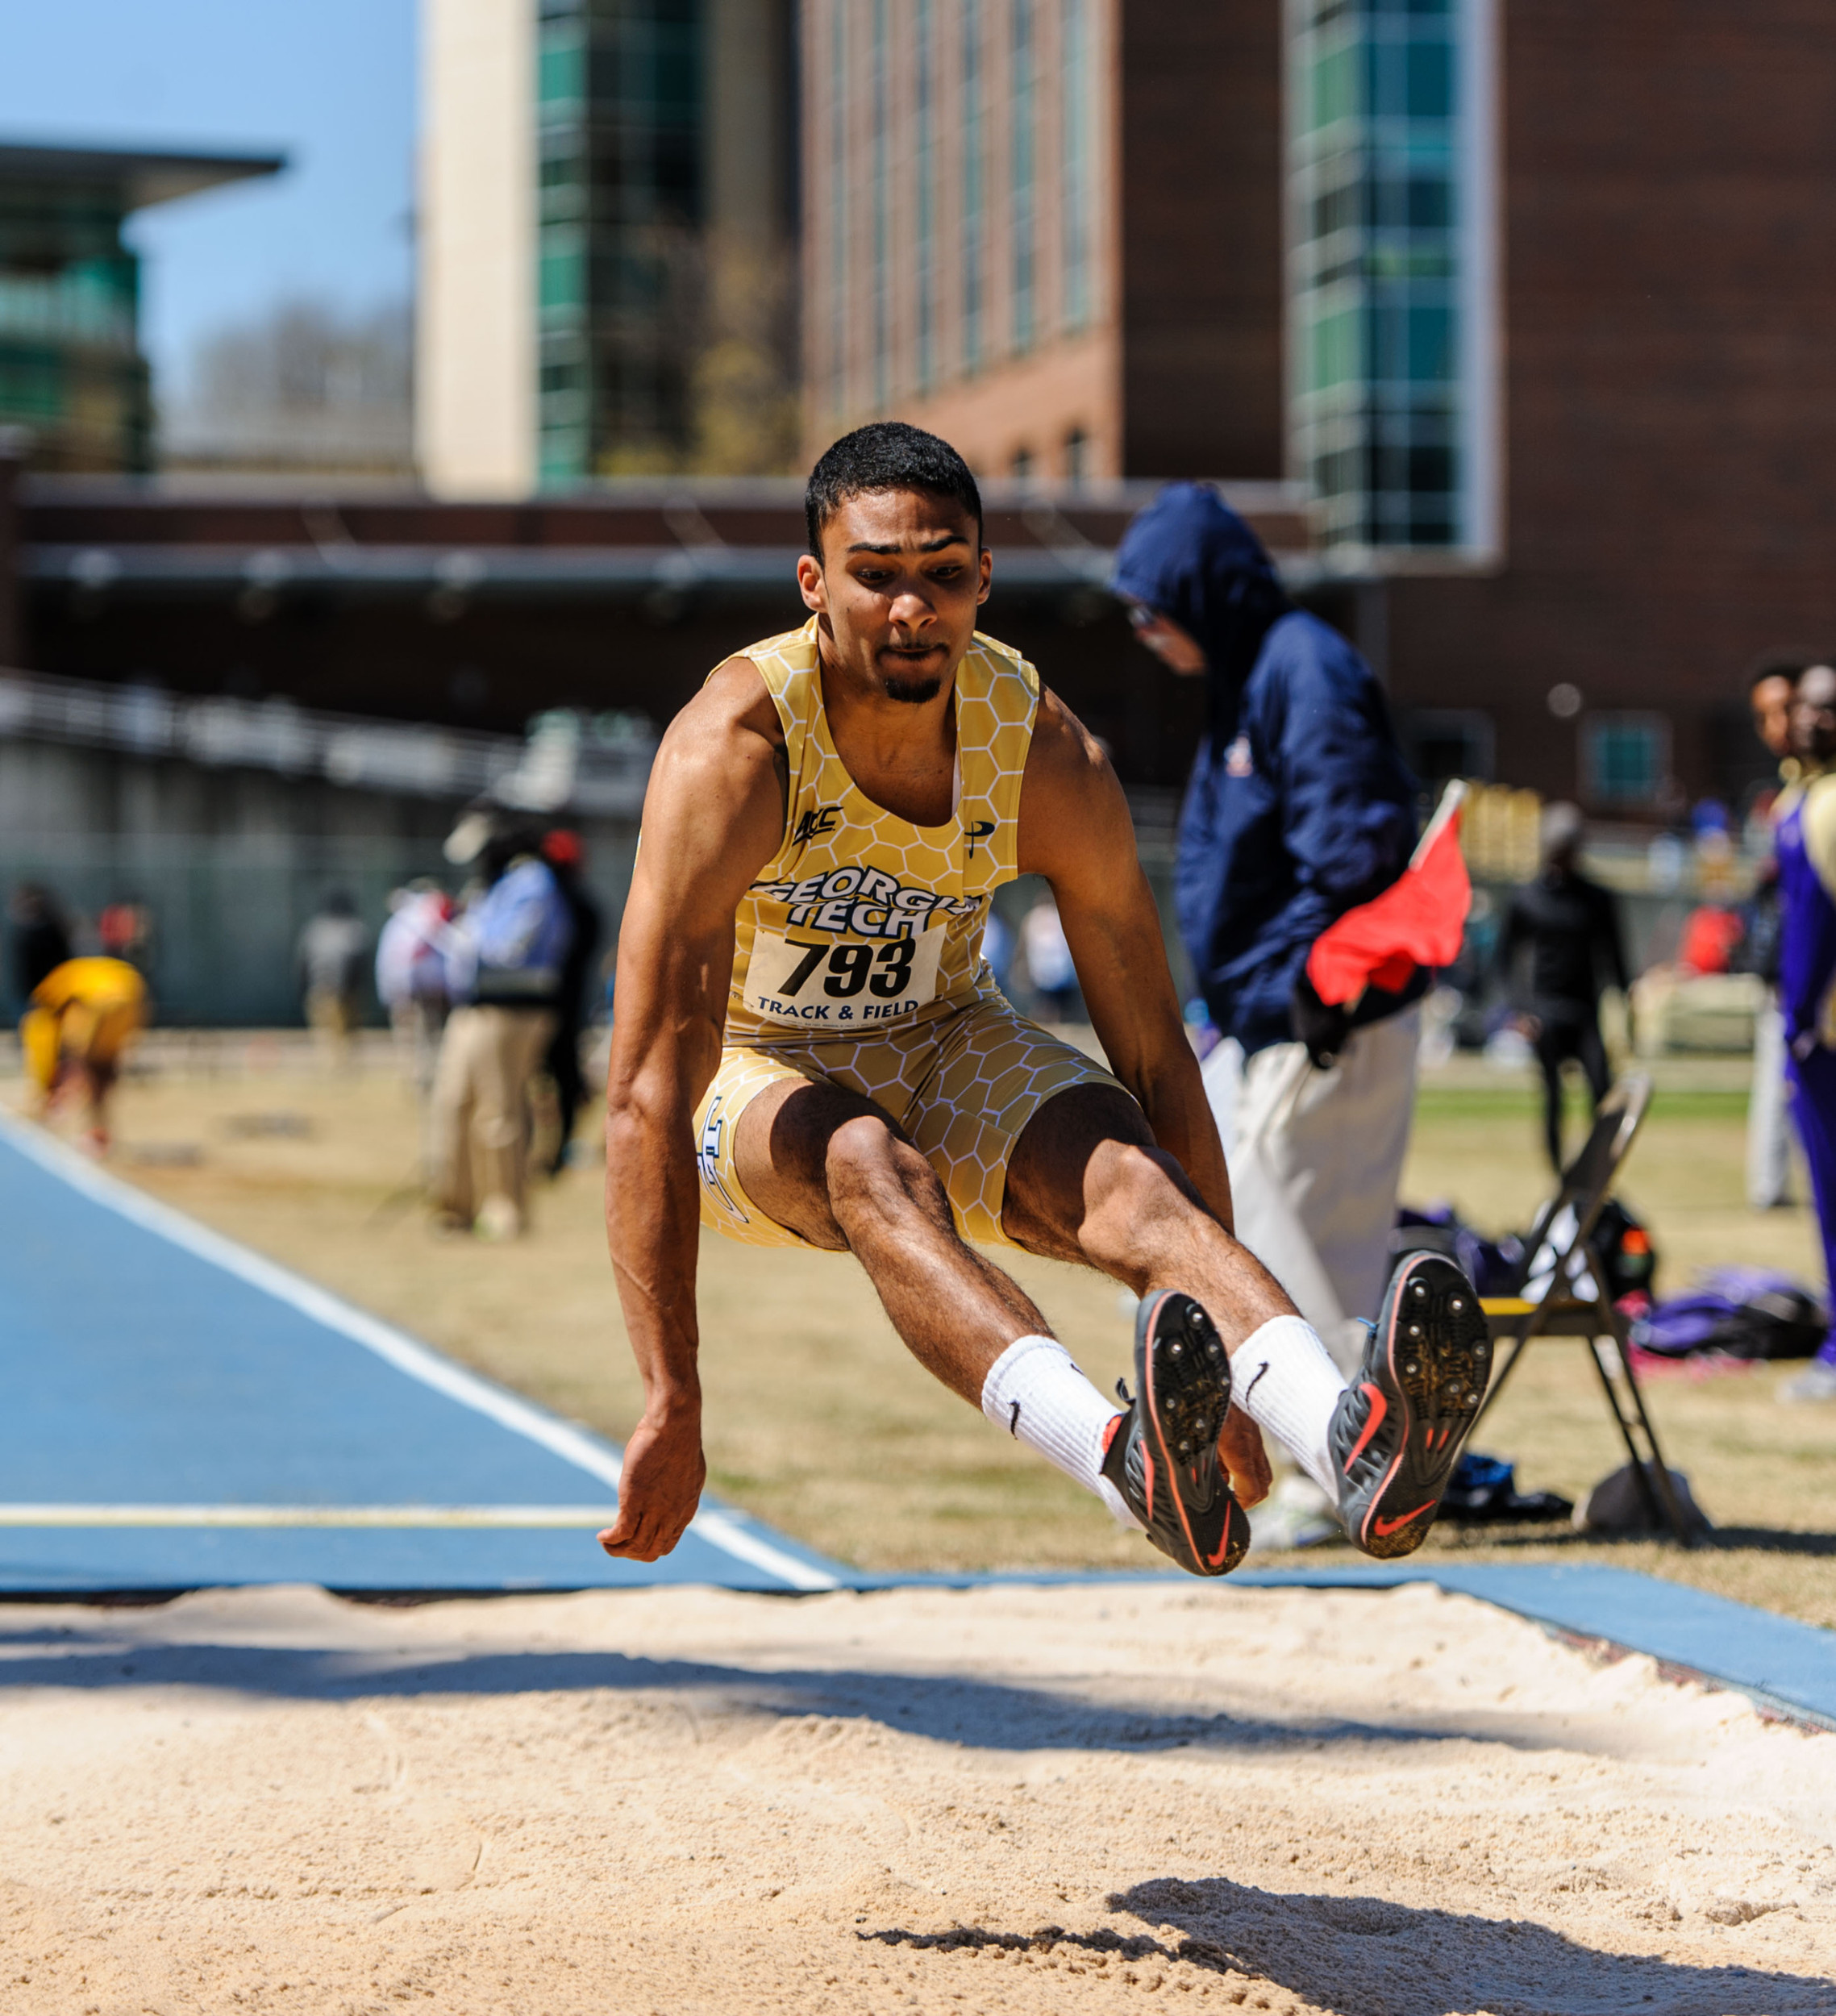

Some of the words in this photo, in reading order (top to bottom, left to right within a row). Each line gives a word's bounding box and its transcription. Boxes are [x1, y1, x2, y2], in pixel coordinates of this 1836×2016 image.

[786, 897, 930, 940] TECH
[776, 938, 917, 998] 793
[757, 996, 831, 1020] TRACK
[838, 1006, 854, 1020] &
[863, 1000, 919, 1019] FIELD
